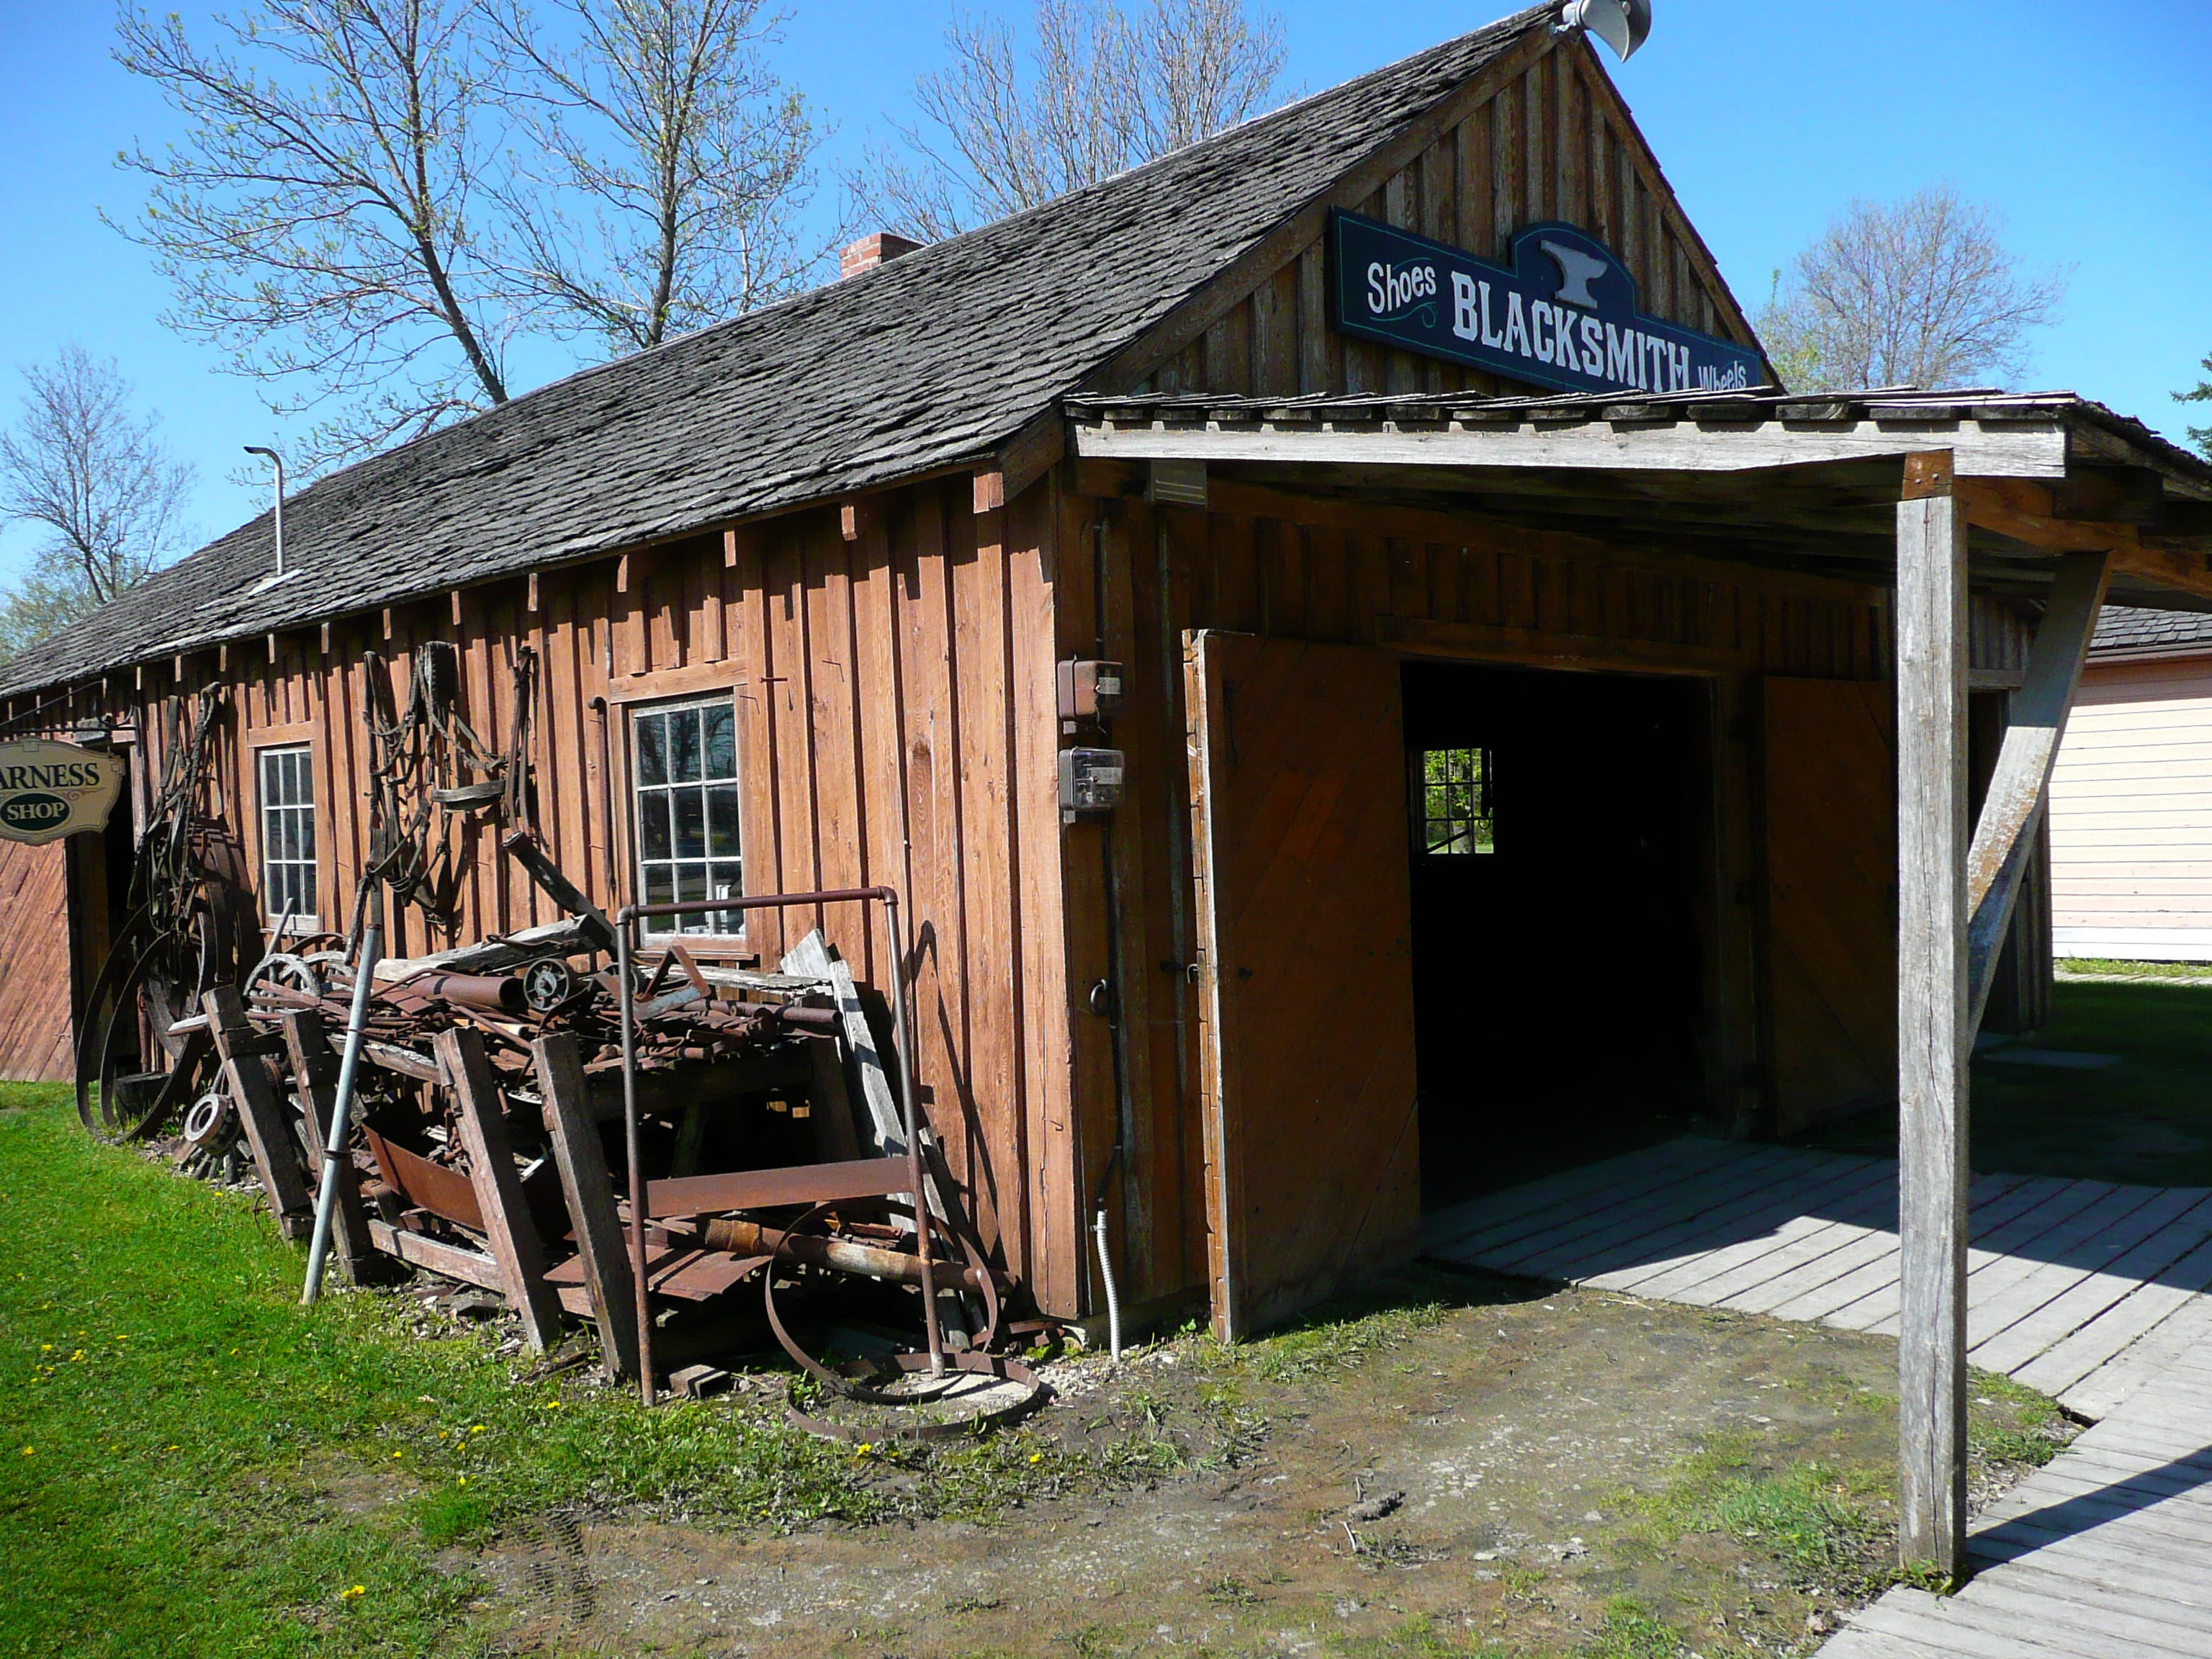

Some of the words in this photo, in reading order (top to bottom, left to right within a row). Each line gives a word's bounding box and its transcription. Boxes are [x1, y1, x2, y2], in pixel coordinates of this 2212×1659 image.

[1367, 262, 1437, 313] Shoes
[1451, 270, 1690, 393] BLACKSMITH
[1698, 360, 1747, 392] Wheels
[6, 802, 66, 820] SHOP
